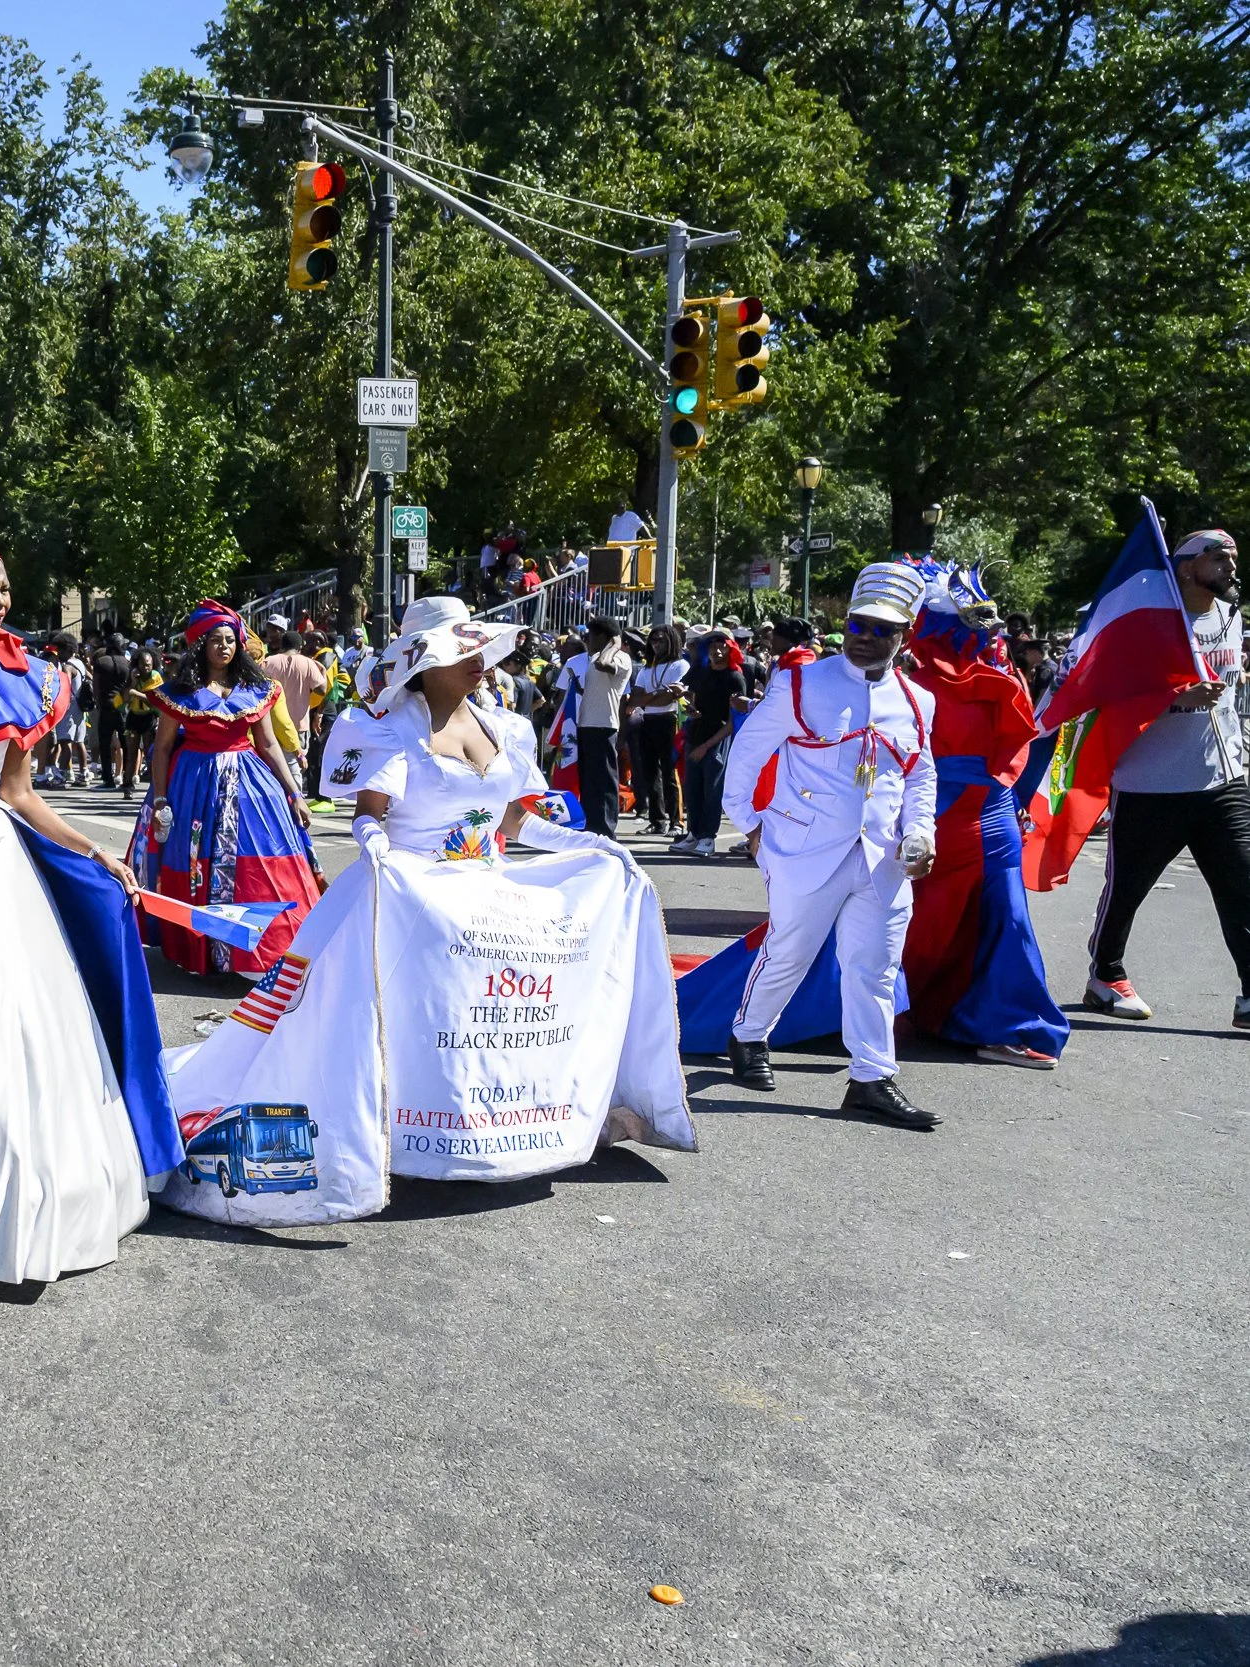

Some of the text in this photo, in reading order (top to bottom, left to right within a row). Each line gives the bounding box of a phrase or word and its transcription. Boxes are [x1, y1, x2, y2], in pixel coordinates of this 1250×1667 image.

[363, 385, 414, 399] PASSENGER
[362, 403, 414, 416] CARS ONLY
[411, 542, 426, 550] KEEP
[813, 538, 828, 548] WAY
[462, 929, 478, 942] OF
[449, 944, 590, 965] OF AMERICAN INDEPENDENCE
[484, 967, 553, 1003] 1804
[470, 1004, 558, 1024] THE FIRST
[436, 1025, 574, 1050] BLACK REPUBLIC
[469, 1085, 526, 1104] TODAY
[265, 1107, 292, 1116] TRANSIT
[396, 1104, 572, 1130] HAITIANS CONTINUE
[403, 1134, 430, 1153] TO
